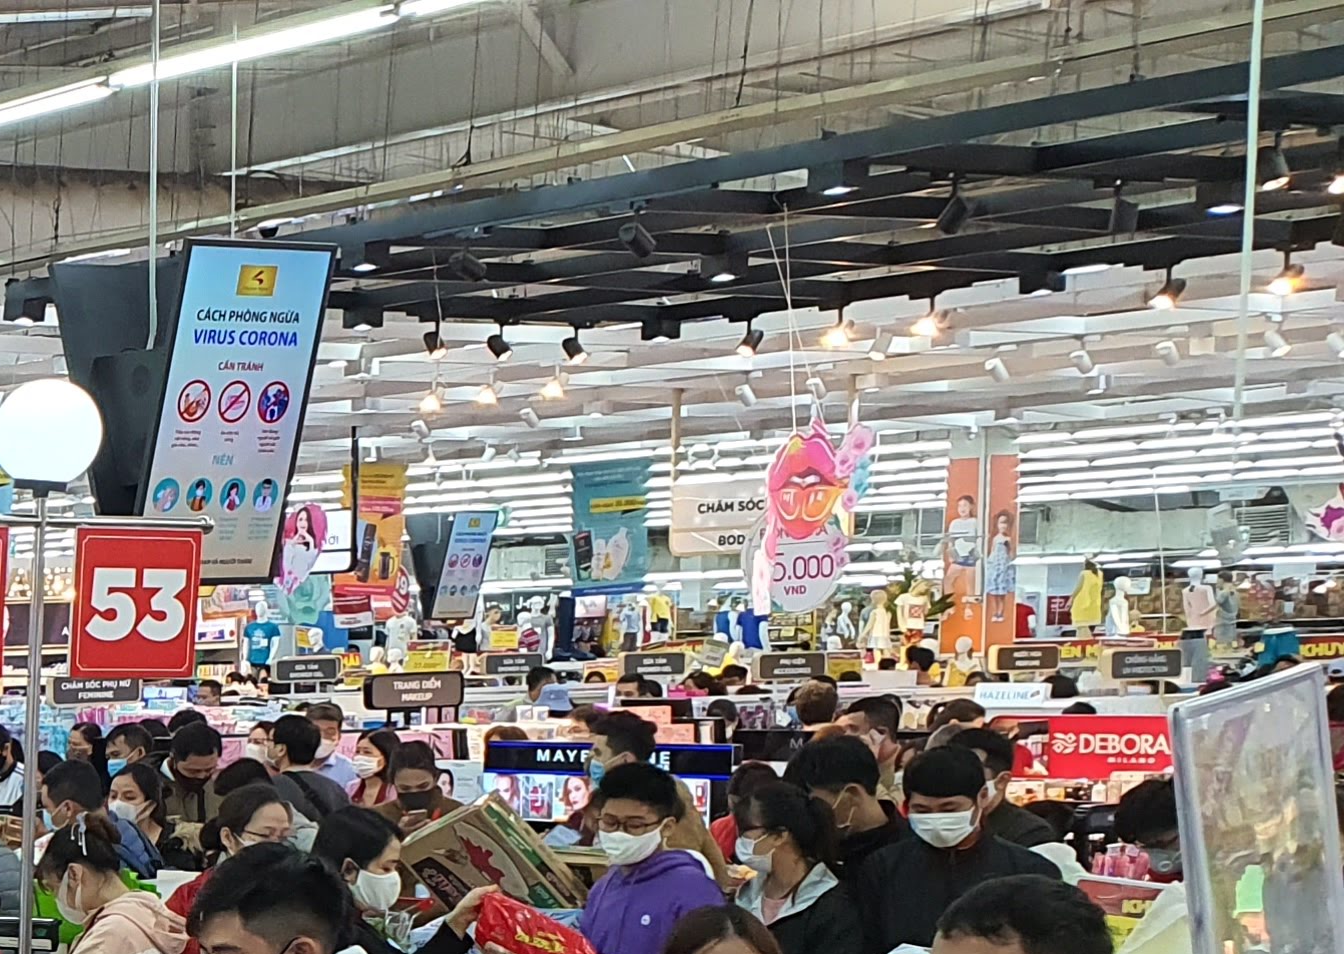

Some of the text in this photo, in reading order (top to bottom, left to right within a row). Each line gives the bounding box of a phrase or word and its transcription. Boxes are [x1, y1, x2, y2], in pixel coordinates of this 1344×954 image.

[196, 307, 300, 323] CÁCH PHÒNG NGỪA
[194, 328, 299, 346] VIRUS CORONA
[737, 497, 765, 511] SÓC
[717, 533, 746, 546] BOD
[773, 554, 834, 582] 5.000
[784, 585, 807, 596] VND
[84, 567, 188, 642] 53
[393, 679, 420, 691] TRANG
[401, 692, 434, 702] MAKEUP
[979, 690, 1030, 700] HAZELINE
[1078, 733, 1171, 755] DEBORA
